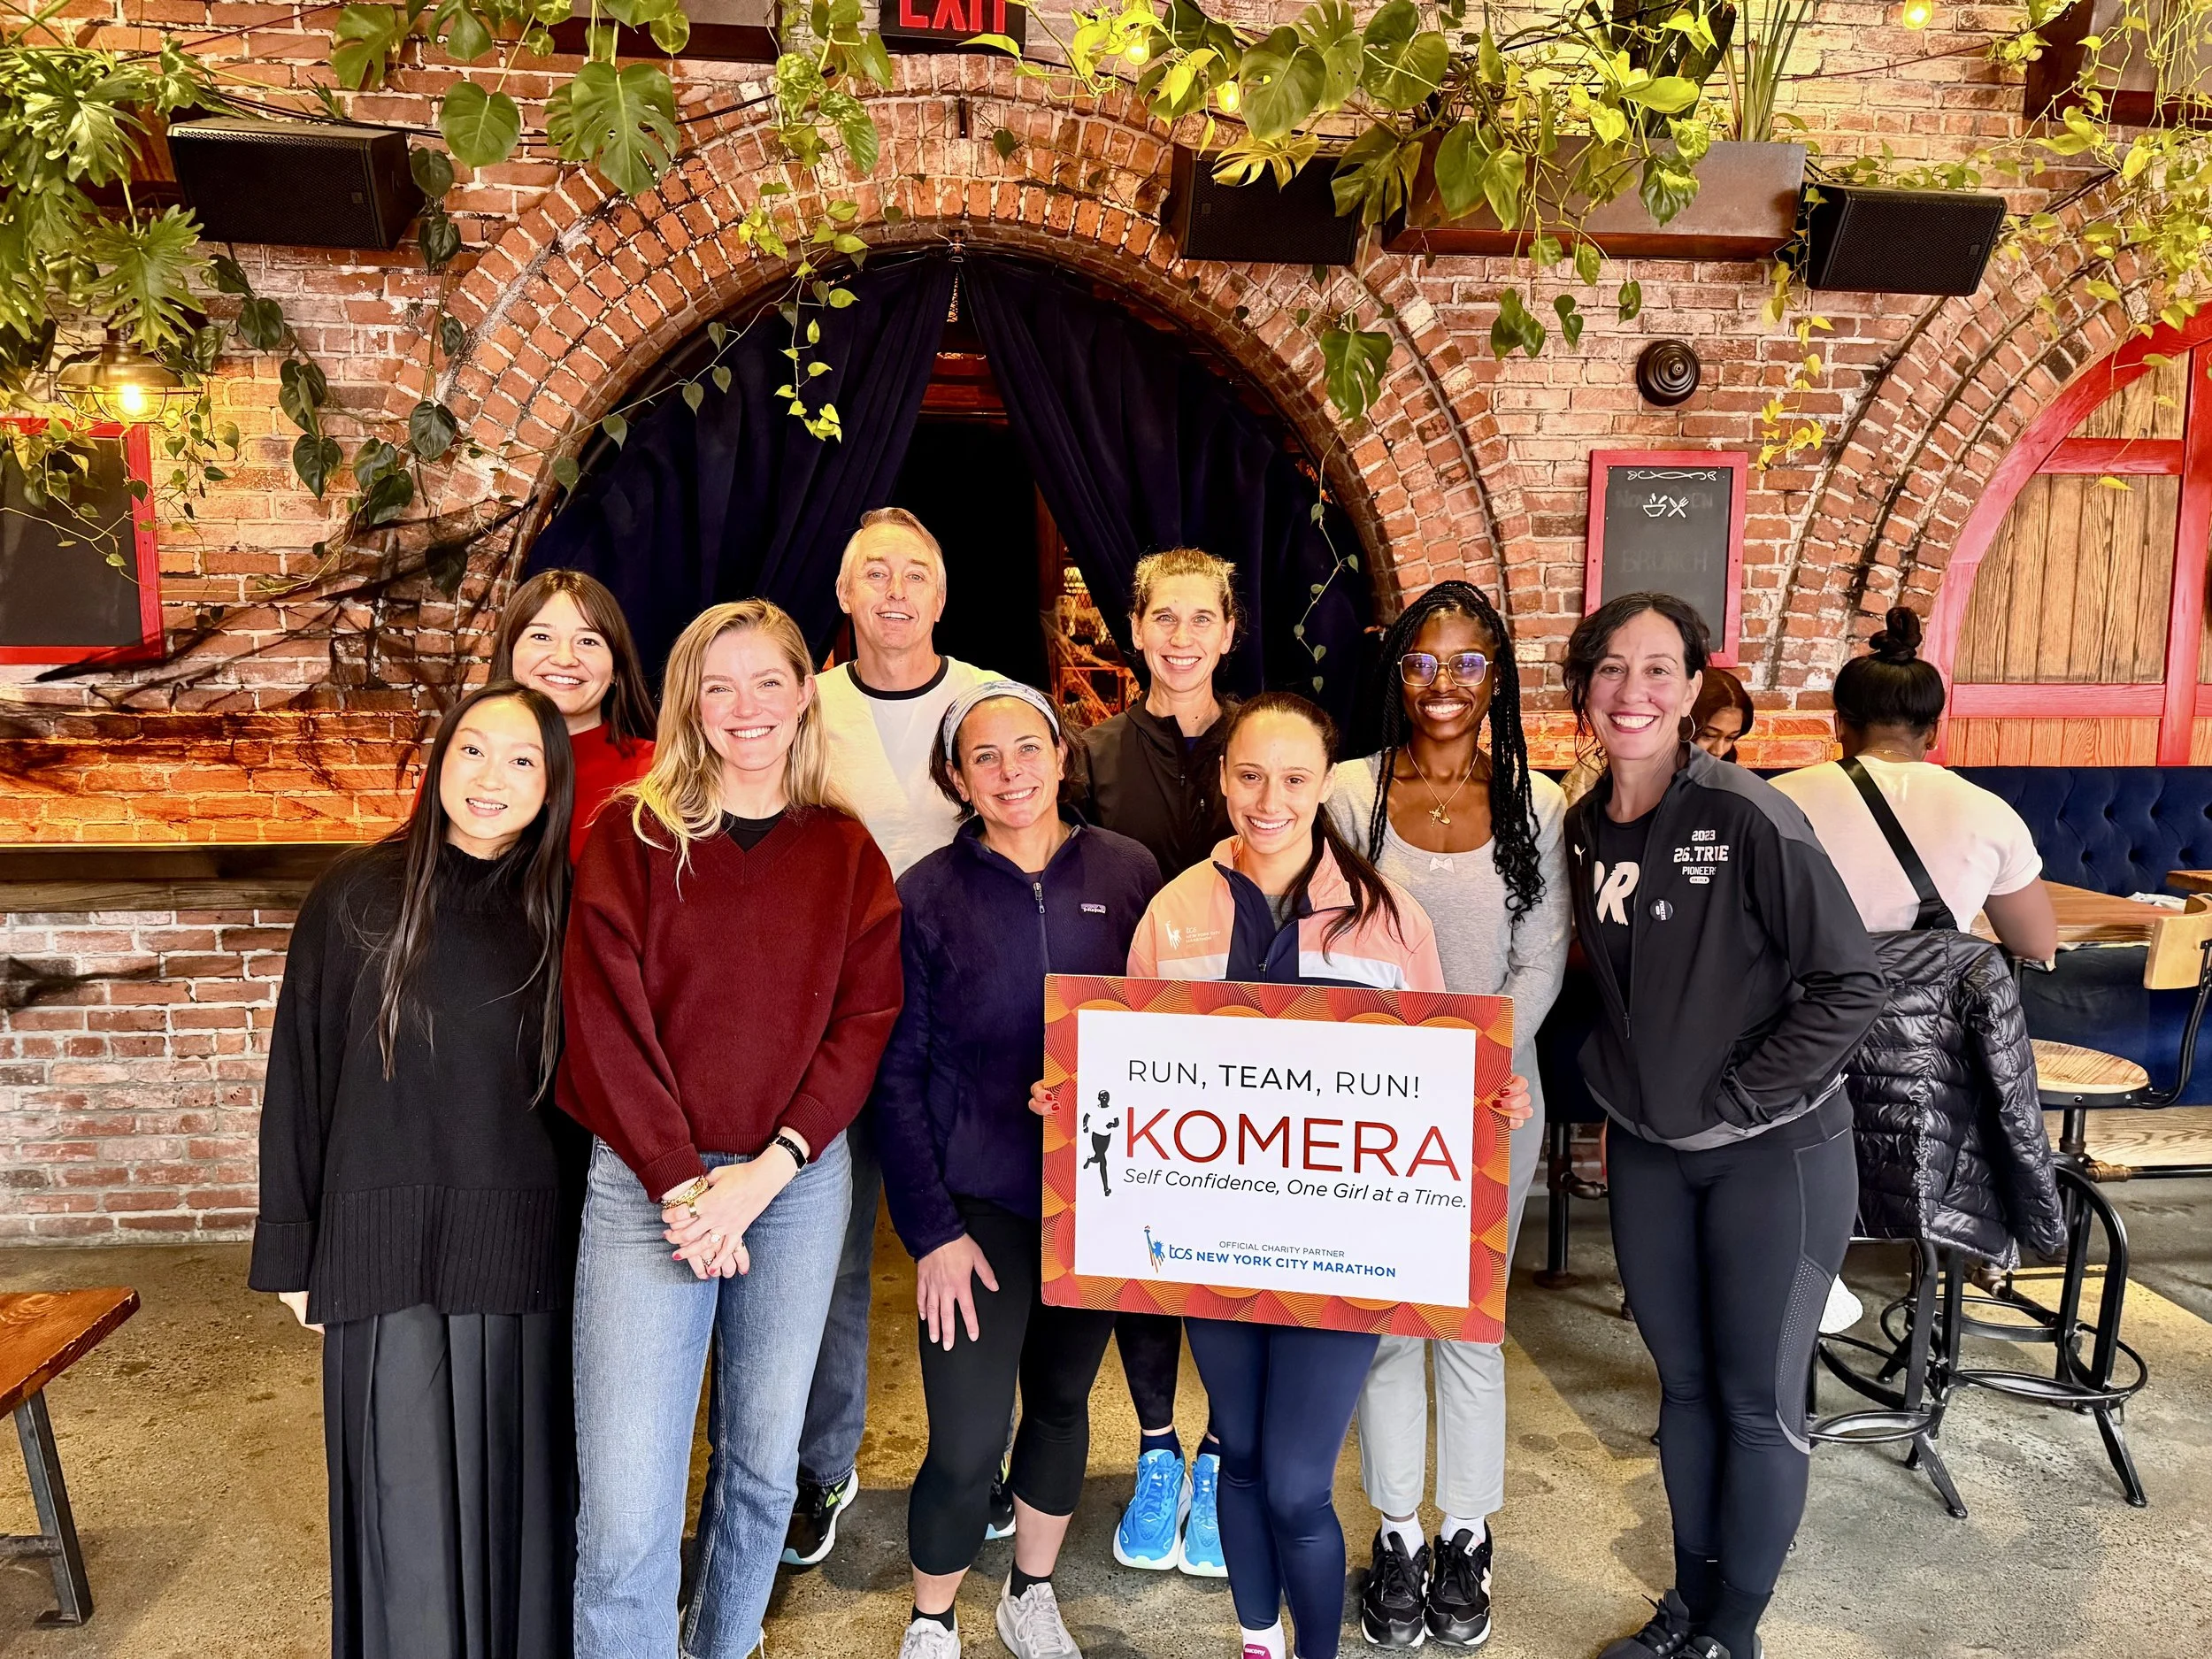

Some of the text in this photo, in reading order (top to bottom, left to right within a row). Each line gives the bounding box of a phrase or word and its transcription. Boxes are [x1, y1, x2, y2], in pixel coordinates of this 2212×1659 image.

[1692, 830, 1716, 841] 2023
[1129, 1060, 1419, 1099] RUN, TEAM, RUN!
[1126, 1107, 1462, 1182] KOMERA
[1123, 1169, 1466, 1209] Self Confidence, One Girl at a Time.
[1169, 1244, 1396, 1278] tcs NEW YORK CITY MARATHON
[1218, 1240, 1345, 1258] OFFICIAL CHARITY PARTNER
